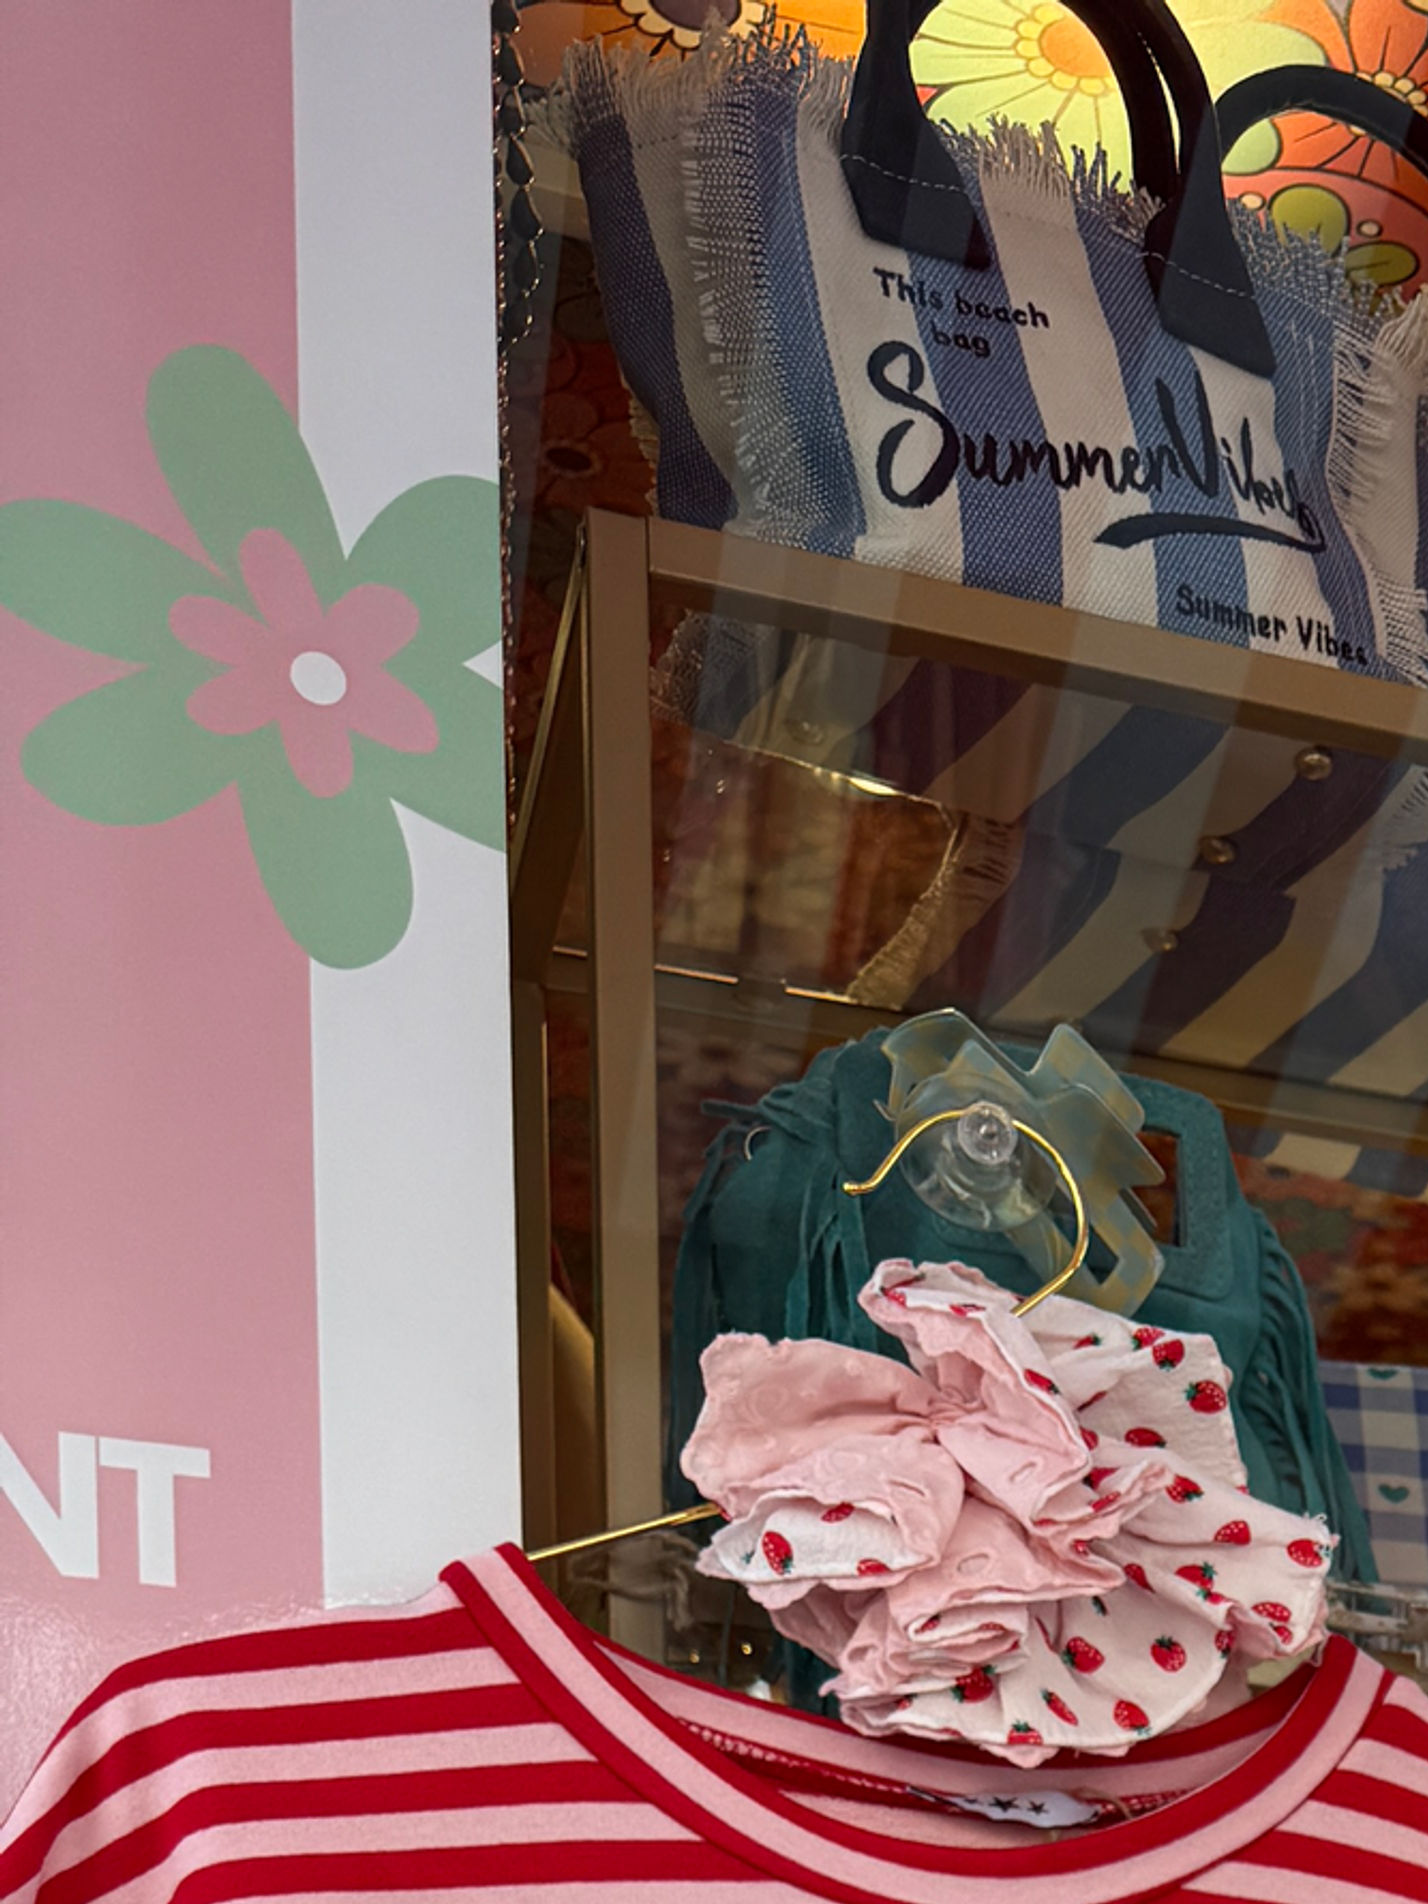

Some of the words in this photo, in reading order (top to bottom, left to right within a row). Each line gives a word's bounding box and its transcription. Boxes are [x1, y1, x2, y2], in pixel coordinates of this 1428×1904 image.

[872, 266, 943, 311] This
[955, 289, 1049, 328] beach
[931, 322, 991, 358] bag
[1176, 584, 1287, 643] Summer
[1296, 615, 1368, 666] Vibes
